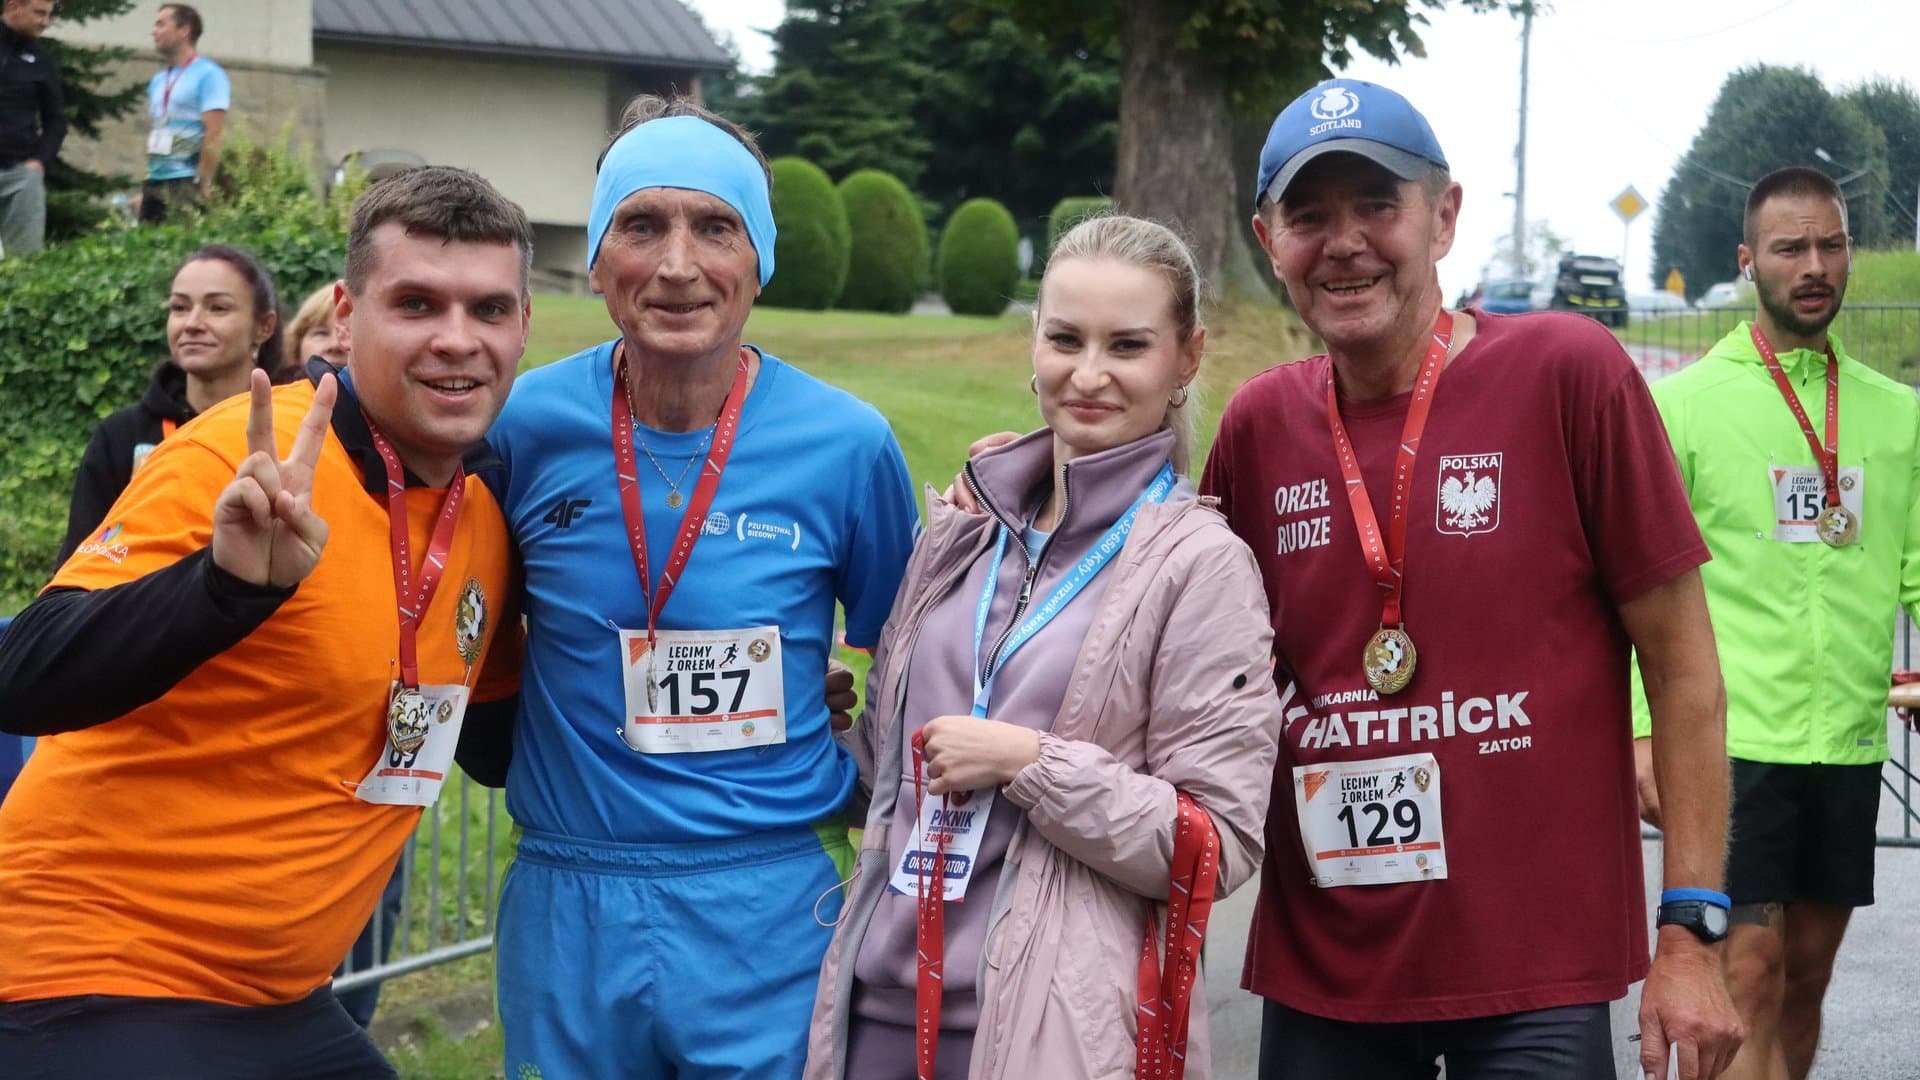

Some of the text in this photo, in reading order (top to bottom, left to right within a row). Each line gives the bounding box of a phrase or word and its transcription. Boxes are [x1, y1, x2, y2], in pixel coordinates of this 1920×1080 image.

[1309, 119, 1362, 137] SCOTLAND
[1442, 455, 1499, 471] POLSKA
[1274, 478, 1331, 516] ORZEŁ
[1786, 493, 1829, 521] 15
[543, 498, 592, 528] 4F
[674, 514, 700, 566] VROBEL
[1277, 515, 1331, 555] RUDZE
[669, 645, 712, 659] LECIMY
[667, 659, 715, 672] Z ORŁEM
[658, 668, 751, 716] 157
[1478, 735, 1532, 755] ZATOR
[1341, 775, 1379, 791] LECIMY
[1341, 789, 1383, 804] Z ORŁEM
[1336, 798, 1421, 848] 129
[931, 833, 954, 844] OREM
[1141, 1027, 1149, 1080] VROBE
